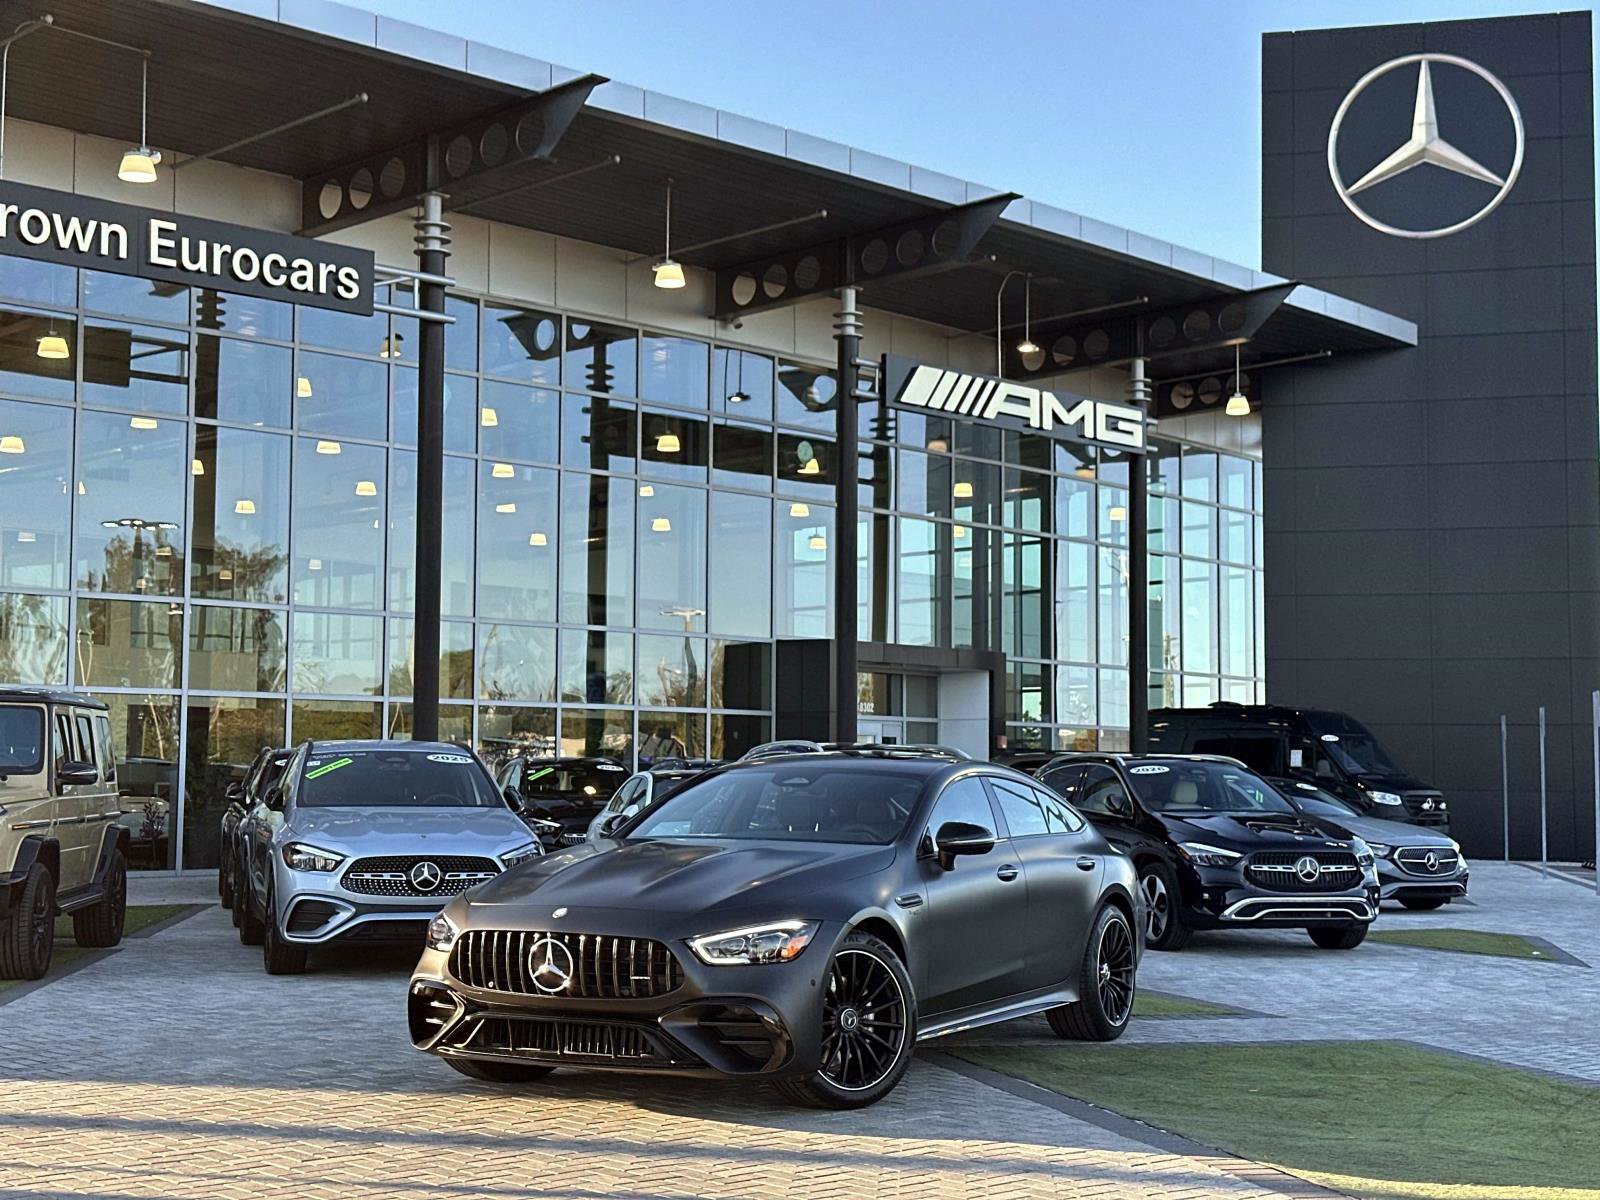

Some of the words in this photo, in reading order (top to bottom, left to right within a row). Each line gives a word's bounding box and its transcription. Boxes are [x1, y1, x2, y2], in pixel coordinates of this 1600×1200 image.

[0, 203, 128, 259] rown
[150, 219, 360, 299] Eurocars
[983, 381, 1143, 447] AMG
